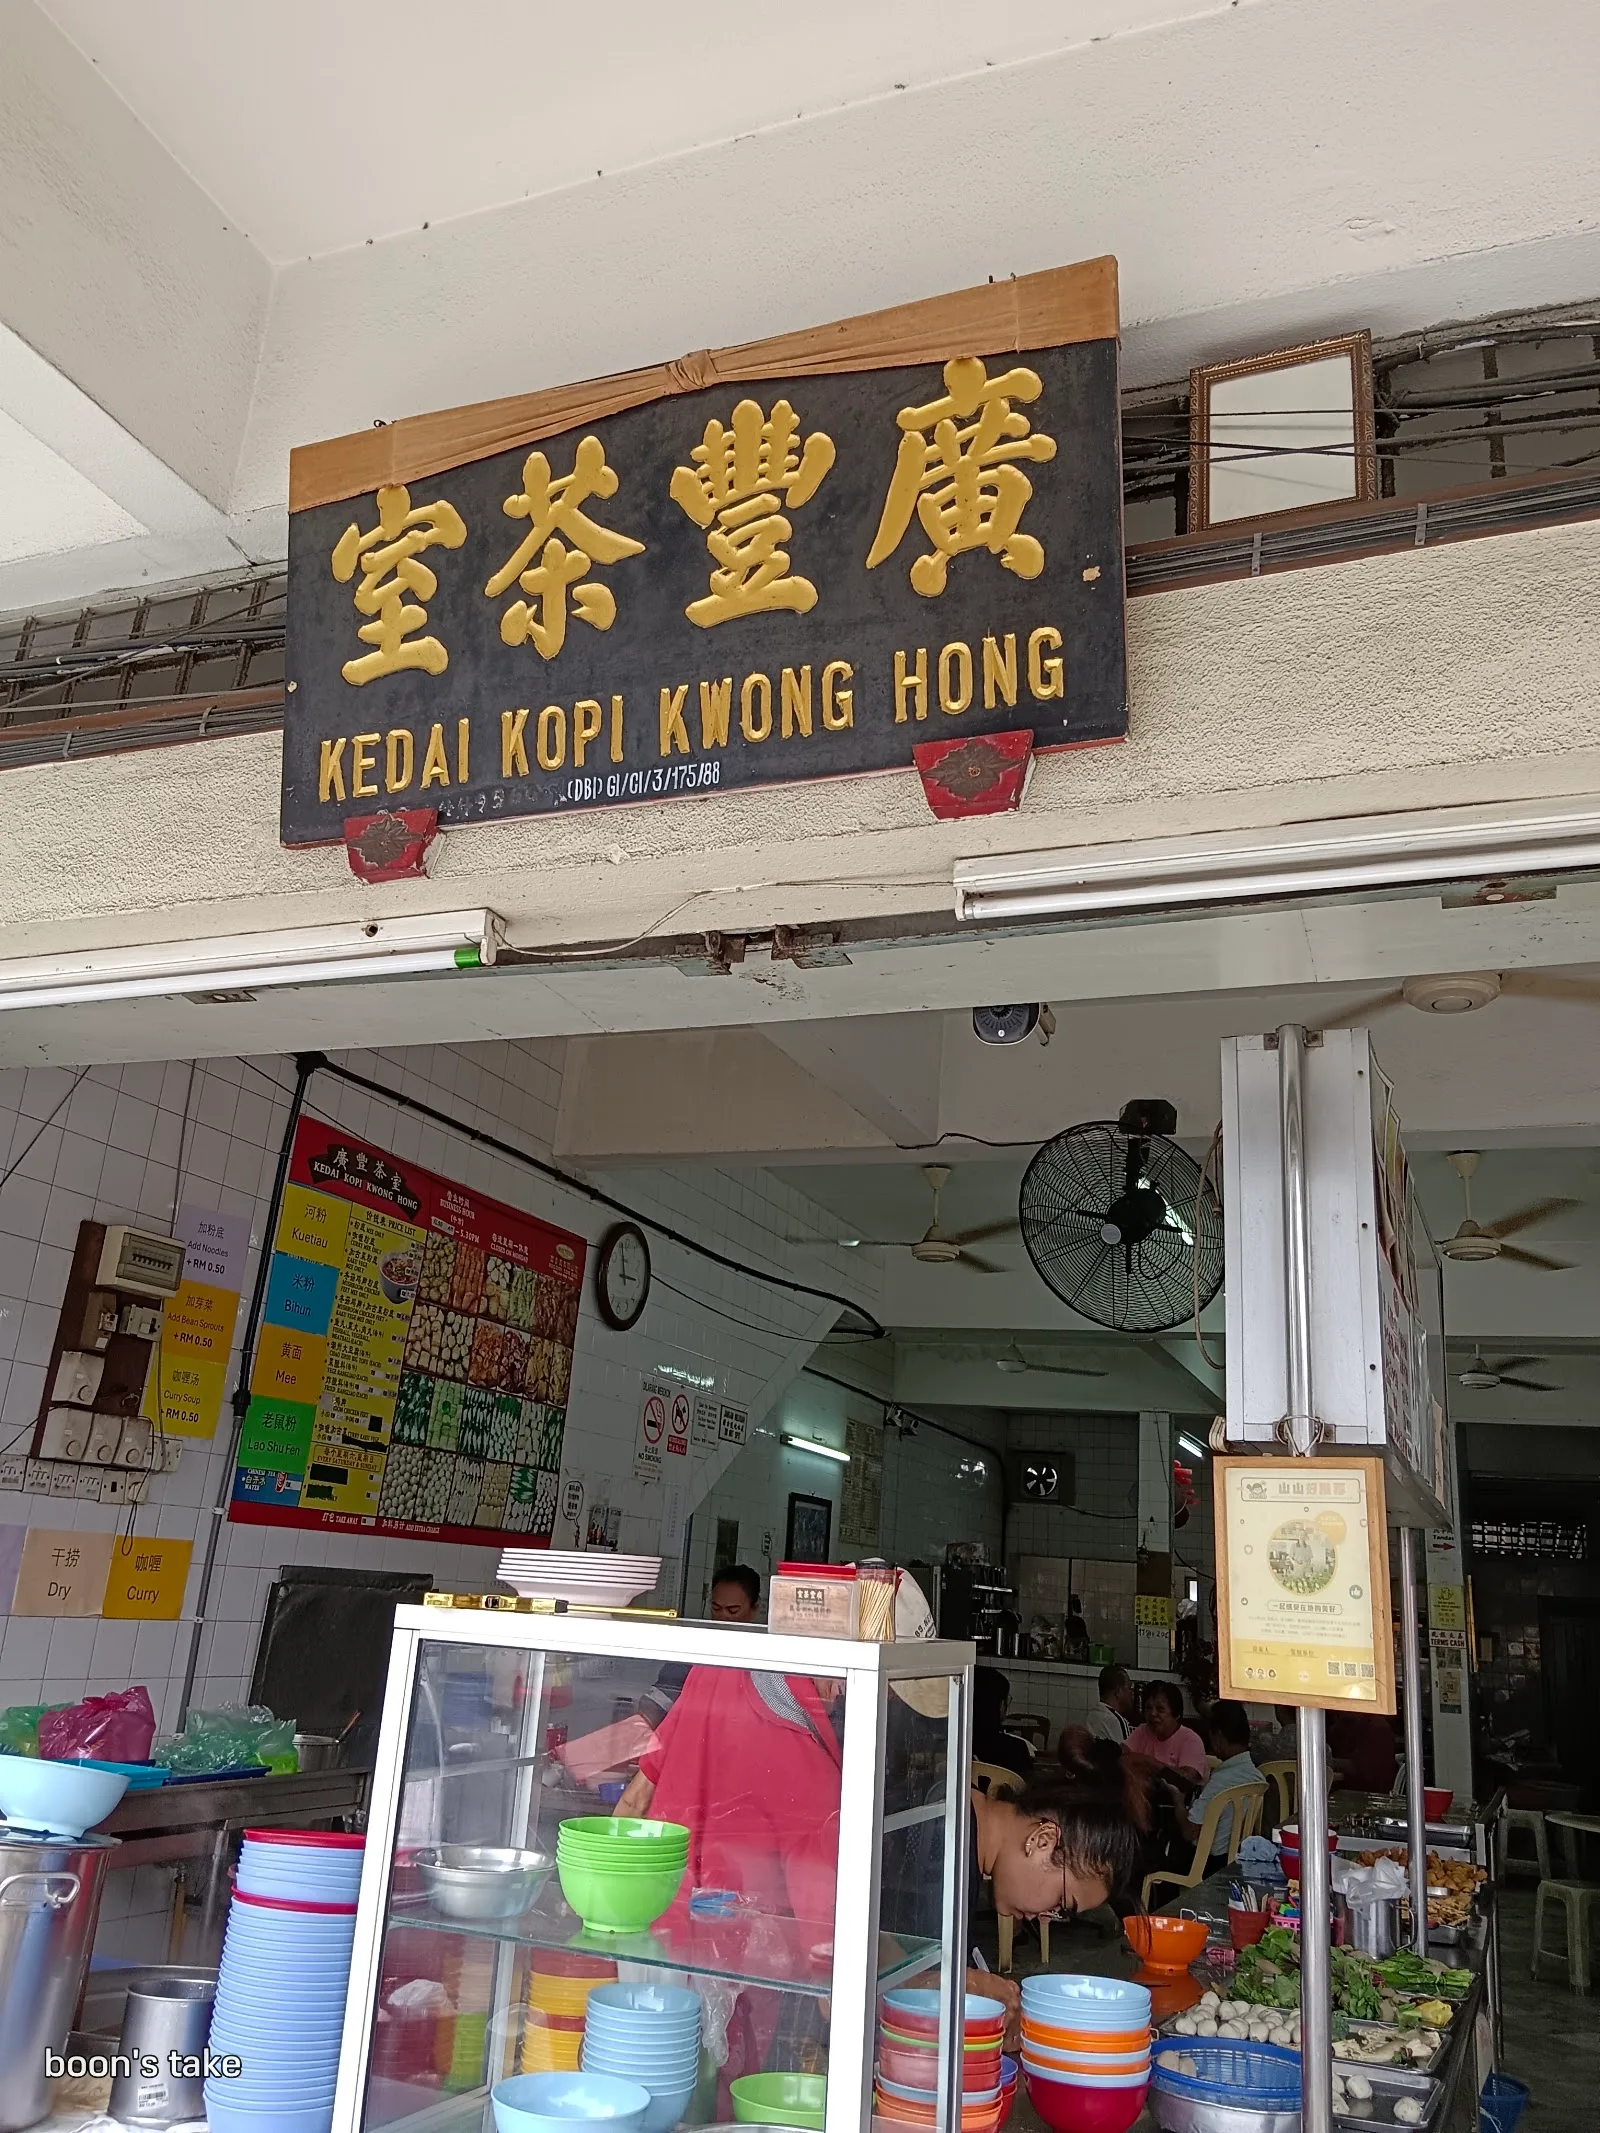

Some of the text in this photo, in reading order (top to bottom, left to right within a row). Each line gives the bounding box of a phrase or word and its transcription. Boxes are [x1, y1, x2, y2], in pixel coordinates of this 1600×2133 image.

[318, 625, 1065, 803] KEDAI KOPI KWONG HONG
[313, 1161, 418, 1210] KEDAI KOPI KWONG HONG
[304, 1203, 328, 1224] 河粉
[198, 1221, 225, 1239] 加粉底
[388, 1219, 417, 1236] PRICE LIST
[291, 1227, 328, 1249] Kuetiau
[187, 1240, 229, 1258] Add Noodles
[193, 1259, 206, 1271] RM
[207, 1264, 225, 1275] 0.50
[292, 1273, 316, 1293] 米粉
[185, 1294, 214, 1312] 加芽菜
[284, 1299, 312, 1317] Bihun
[167, 1312, 224, 1333] Add Bean Sprouts
[180, 1332, 193, 1344] RM
[195, 1335, 213, 1348] 0.50
[281, 1341, 303, 1360] 黄面
[275, 1369, 297, 1385] Mee
[163, 1390, 201, 1405] Curry Soup
[166, 1408, 199, 1423] RM 0.50
[262, 1410, 297, 1432] 老鼠粉
[248, 1438, 300, 1456] Lao Shu Fen
[51, 1548, 81, 1568] 干捞
[135, 1553, 163, 1572] 咖喱
[47, 1582, 71, 1600] Dry
[127, 1586, 159, 1603] Curry
[1431, 1638, 1449, 1646] TERMS
